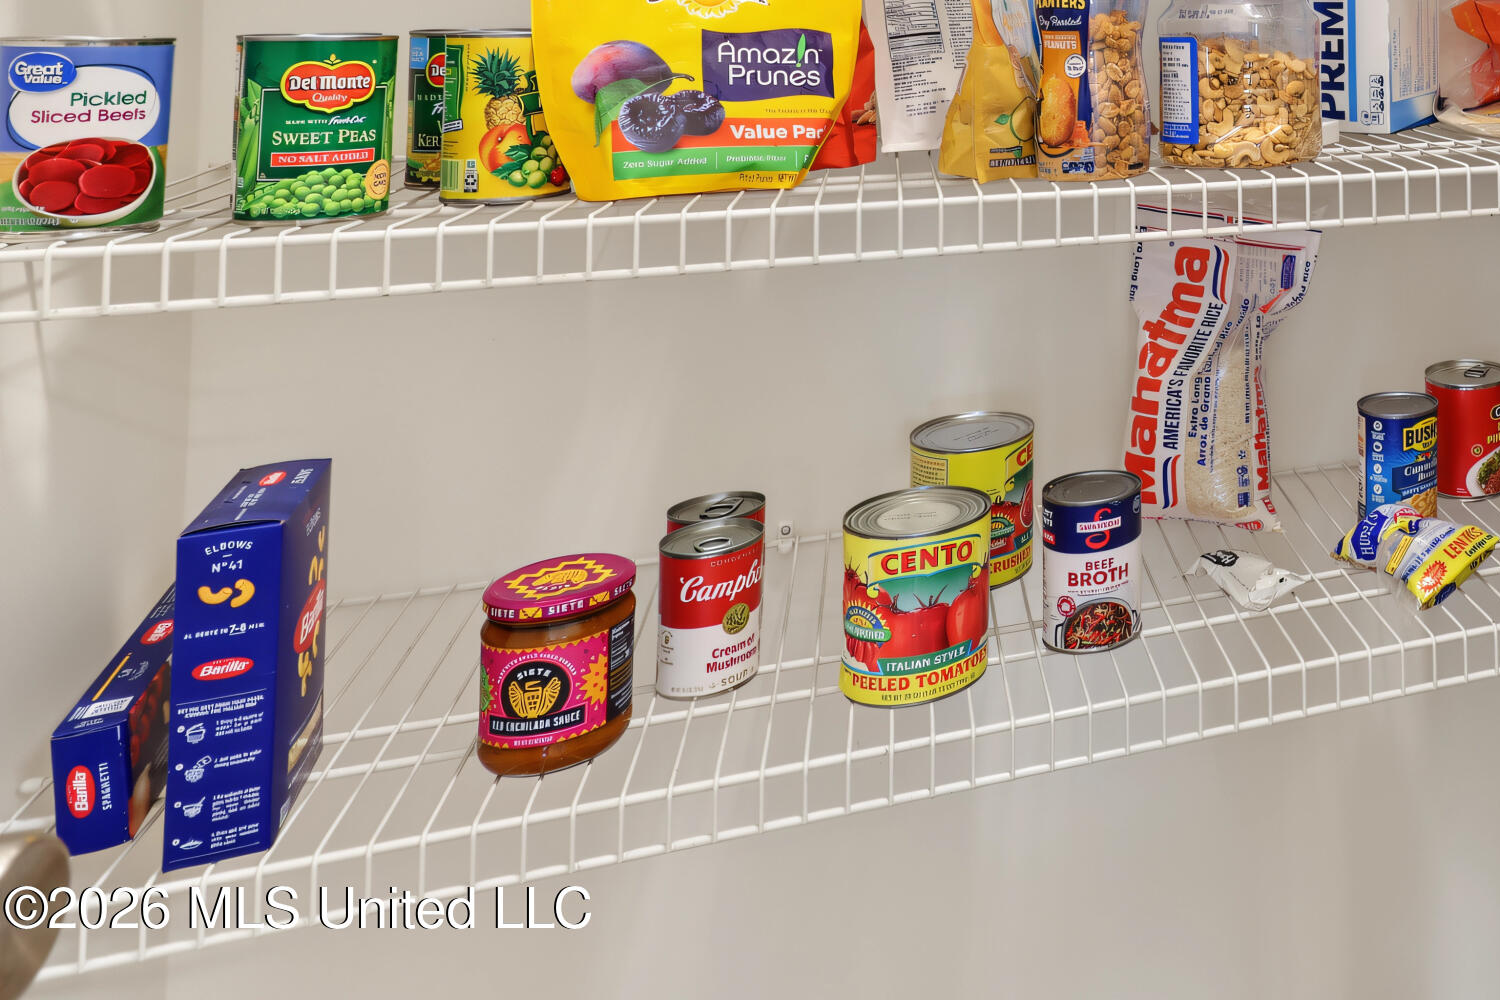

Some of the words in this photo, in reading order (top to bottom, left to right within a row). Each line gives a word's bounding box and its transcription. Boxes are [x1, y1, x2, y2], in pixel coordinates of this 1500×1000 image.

[14, 60, 65, 80] Great
[728, 64, 821, 87] Prunes
[23, 73, 67, 85] Value
[289, 75, 317, 91] Del
[319, 74, 371, 90] Monte
[70, 90, 148, 107] Pickled
[312, 92, 348, 103] Quality
[30, 108, 93, 125] Sliced
[97, 106, 147, 123] Beets
[272, 130, 333, 146] SWEET
[338, 129, 377, 144] PEAS
[729, 124, 789, 140] Value
[278, 155, 297, 164] NO
[624, 160, 645, 169] Zero
[647, 159, 675, 169] Sugar
[1125, 246, 1210, 505] Mahatma
[1163, 379, 1184, 450] AMERICA'S
[1179, 329, 1207, 377] FAVORITE
[1204, 302, 1224, 330] RICE
[1200, 376, 1211, 414] Grano
[1187, 407, 1198, 438] Extra
[204, 540, 253, 556] ELBOWS
[881, 541, 973, 575] CENTO
[1085, 557, 1115, 572] BEEF
[1068, 562, 1129, 587] BROTH
[547, 600, 584, 615] SIETE
[712, 640, 744, 660] Cream
[706, 647, 758, 674] Mushroom
[886, 655, 930, 672] ITALIAN
[934, 646, 966, 664] STYLE
[200, 660, 249, 676] Barilla
[517, 668, 552, 681] SIETE
[721, 670, 749, 686] SOUP
[852, 674, 910, 692] PEELED
[553, 710, 581, 726] SAUCE
[73, 769, 89, 812] Barilla
[100, 760, 113, 811] SPAGHETTI
